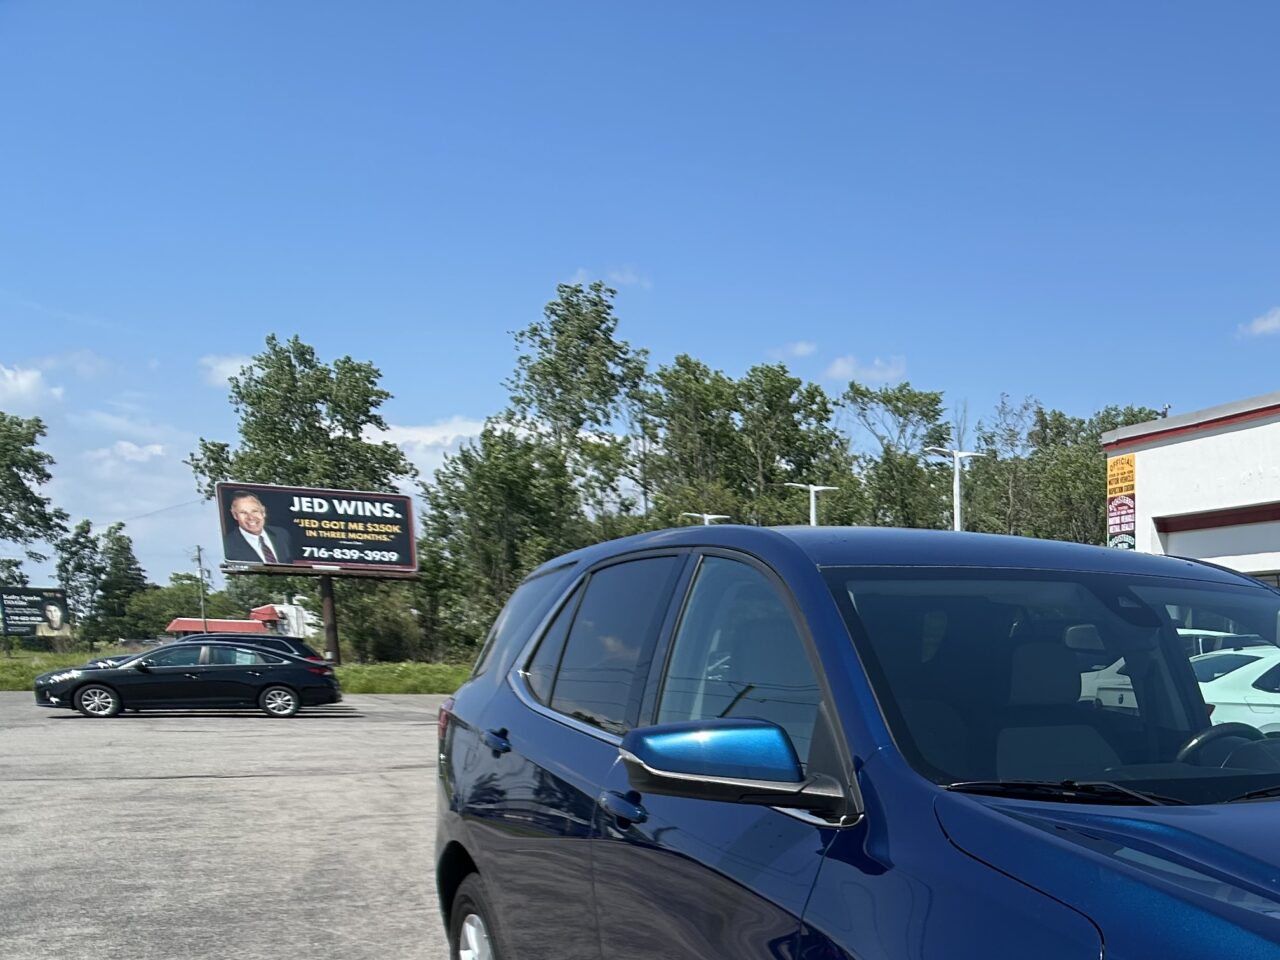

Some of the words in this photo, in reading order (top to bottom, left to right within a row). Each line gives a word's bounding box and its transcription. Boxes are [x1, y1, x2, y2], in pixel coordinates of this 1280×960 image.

[290, 496, 329, 513] JED
[332, 499, 403, 519] WINS.
[321, 520, 346, 529] GOT
[348, 522, 365, 531] ME
[305, 530, 318, 538] IN
[318, 530, 346, 540] THREE
[302, 546, 400, 562] 716-839-3939
